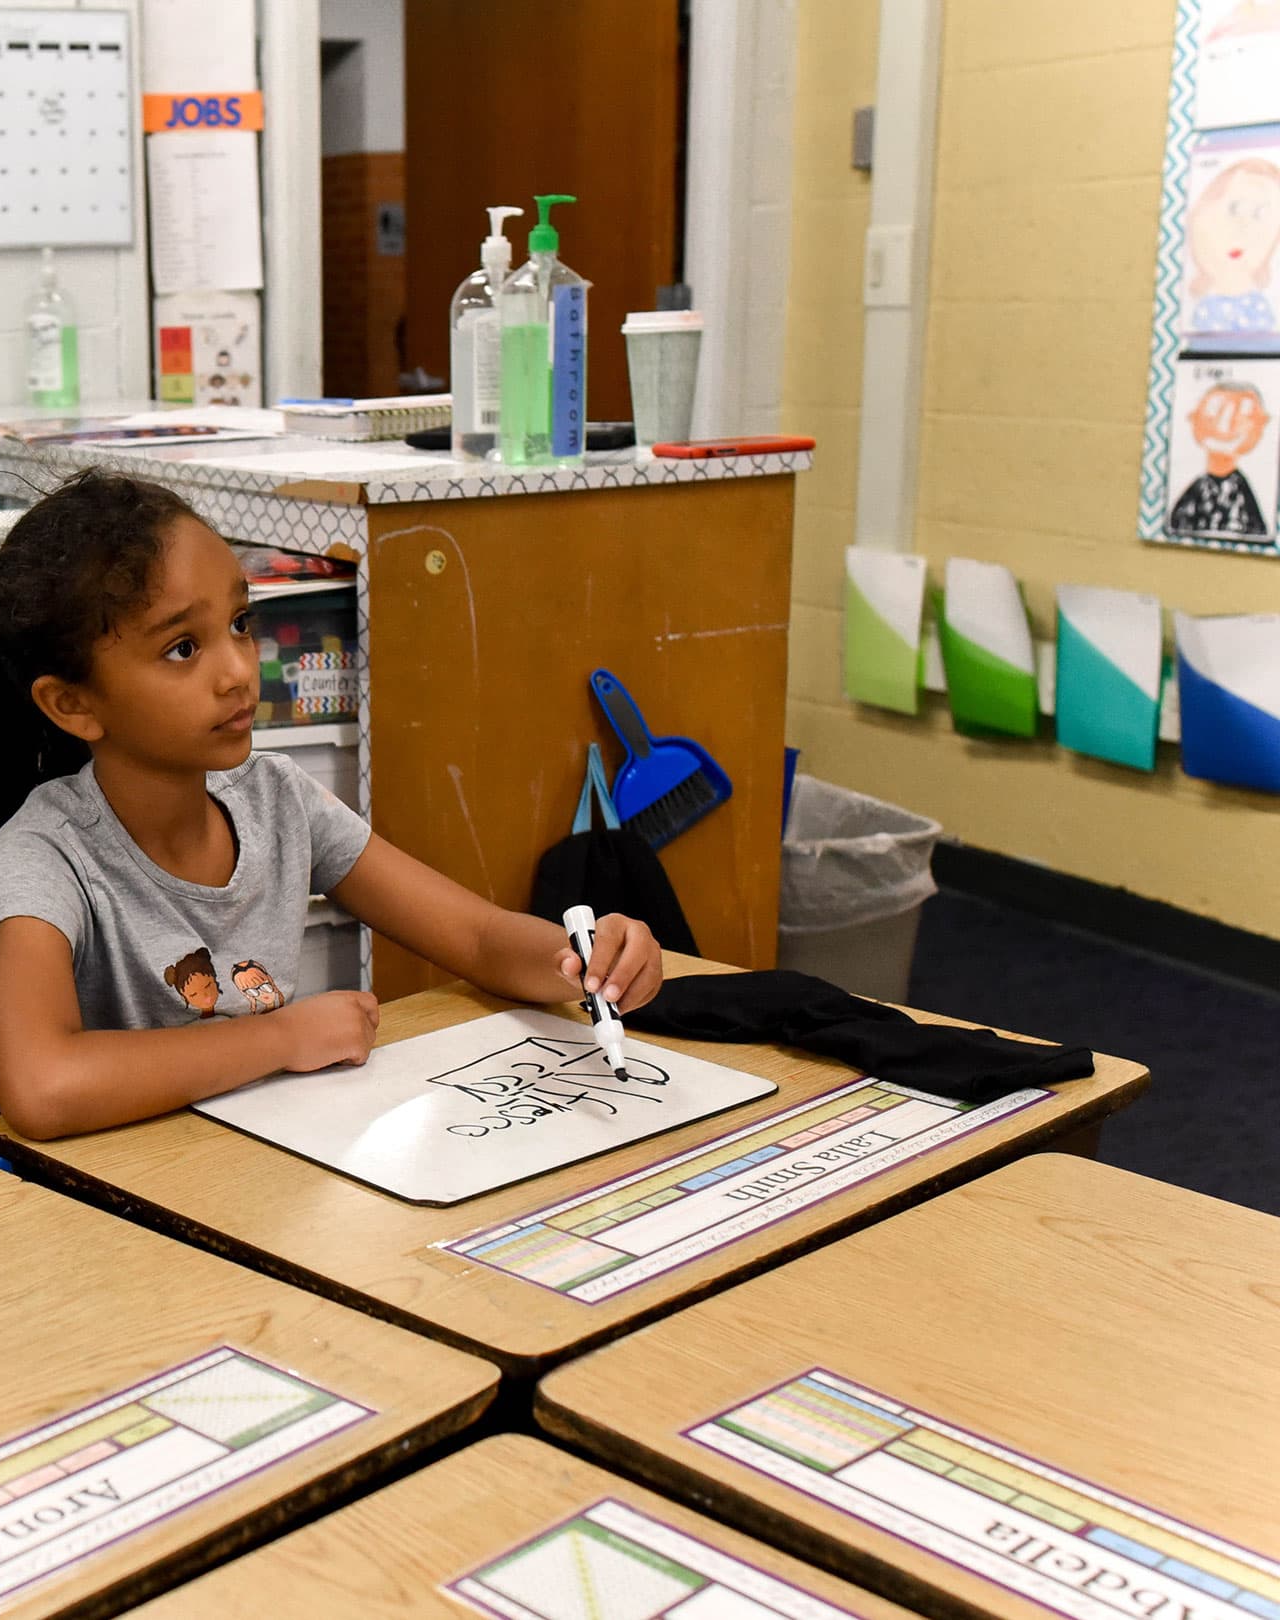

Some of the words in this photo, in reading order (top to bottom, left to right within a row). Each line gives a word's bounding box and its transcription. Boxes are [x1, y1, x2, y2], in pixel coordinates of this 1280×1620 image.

[165, 97, 242, 128] JOBS
[568, 287, 582, 448] Bathroom
[812, 1129, 902, 1162] Laila
[725, 1161, 827, 1201] Smith
[0, 1478, 123, 1540] Aron
